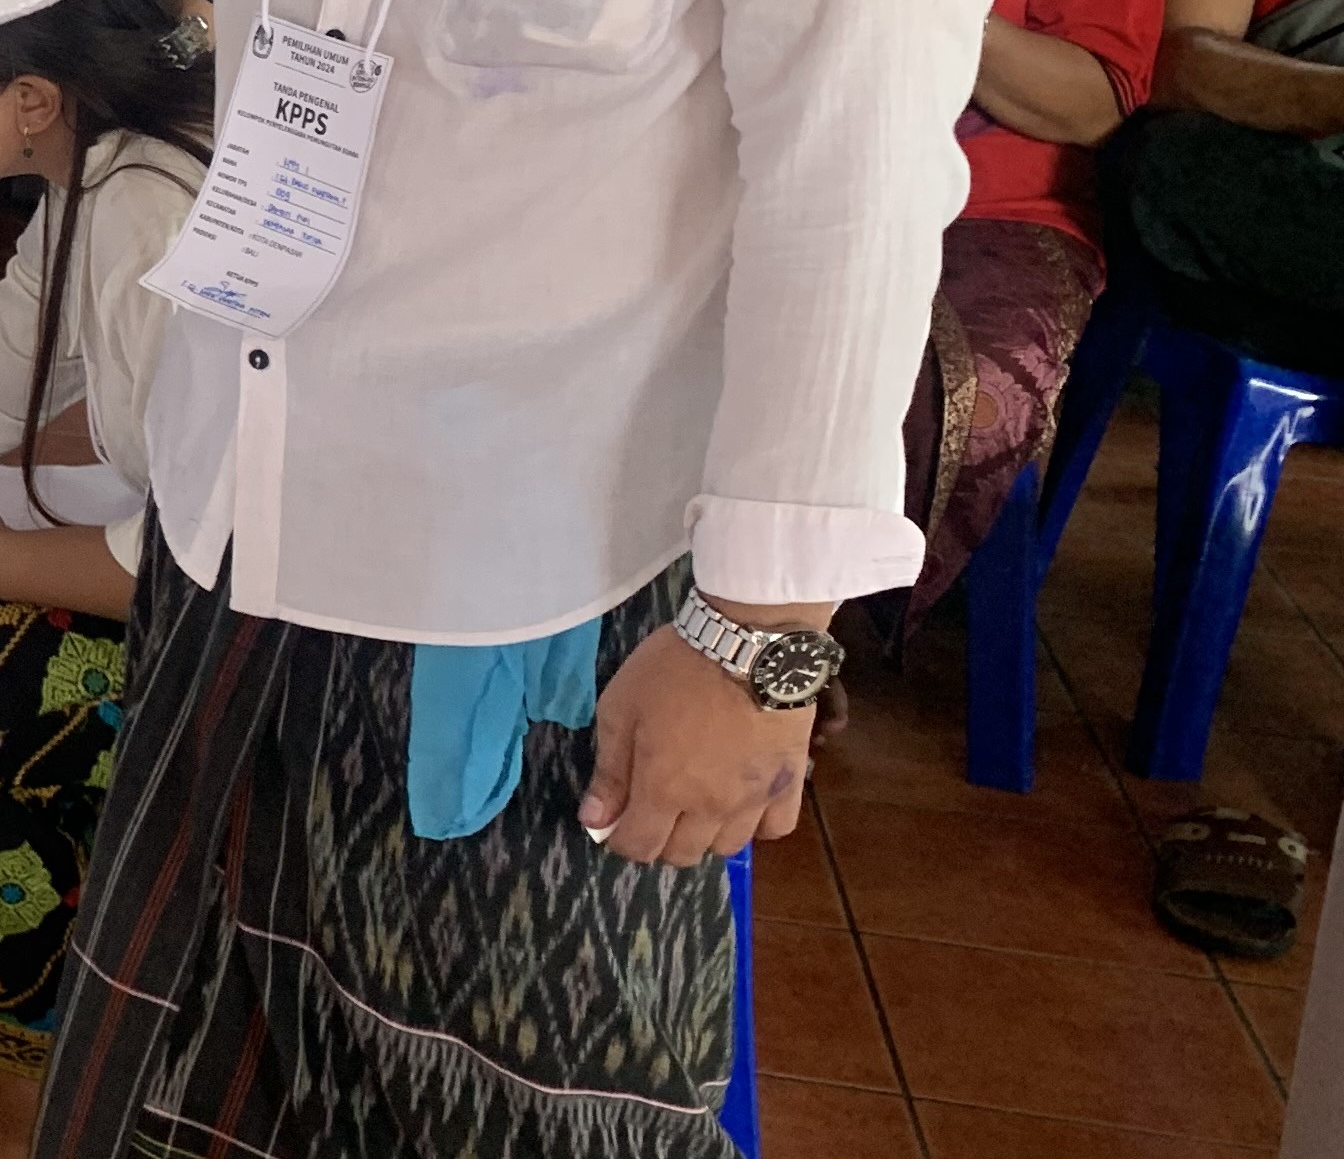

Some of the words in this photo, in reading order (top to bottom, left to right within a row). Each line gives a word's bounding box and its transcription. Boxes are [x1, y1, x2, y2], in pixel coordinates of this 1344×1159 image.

[282, 35, 322, 57] PEMILIHAN
[324, 49, 349, 65] UMUM
[291, 51, 316, 67] TAHUN
[317, 61, 335, 74] 2024
[274, 81, 297, 98] TANDA
[299, 91, 339, 113] PENGENAL
[276, 98, 328, 135] KPPS
